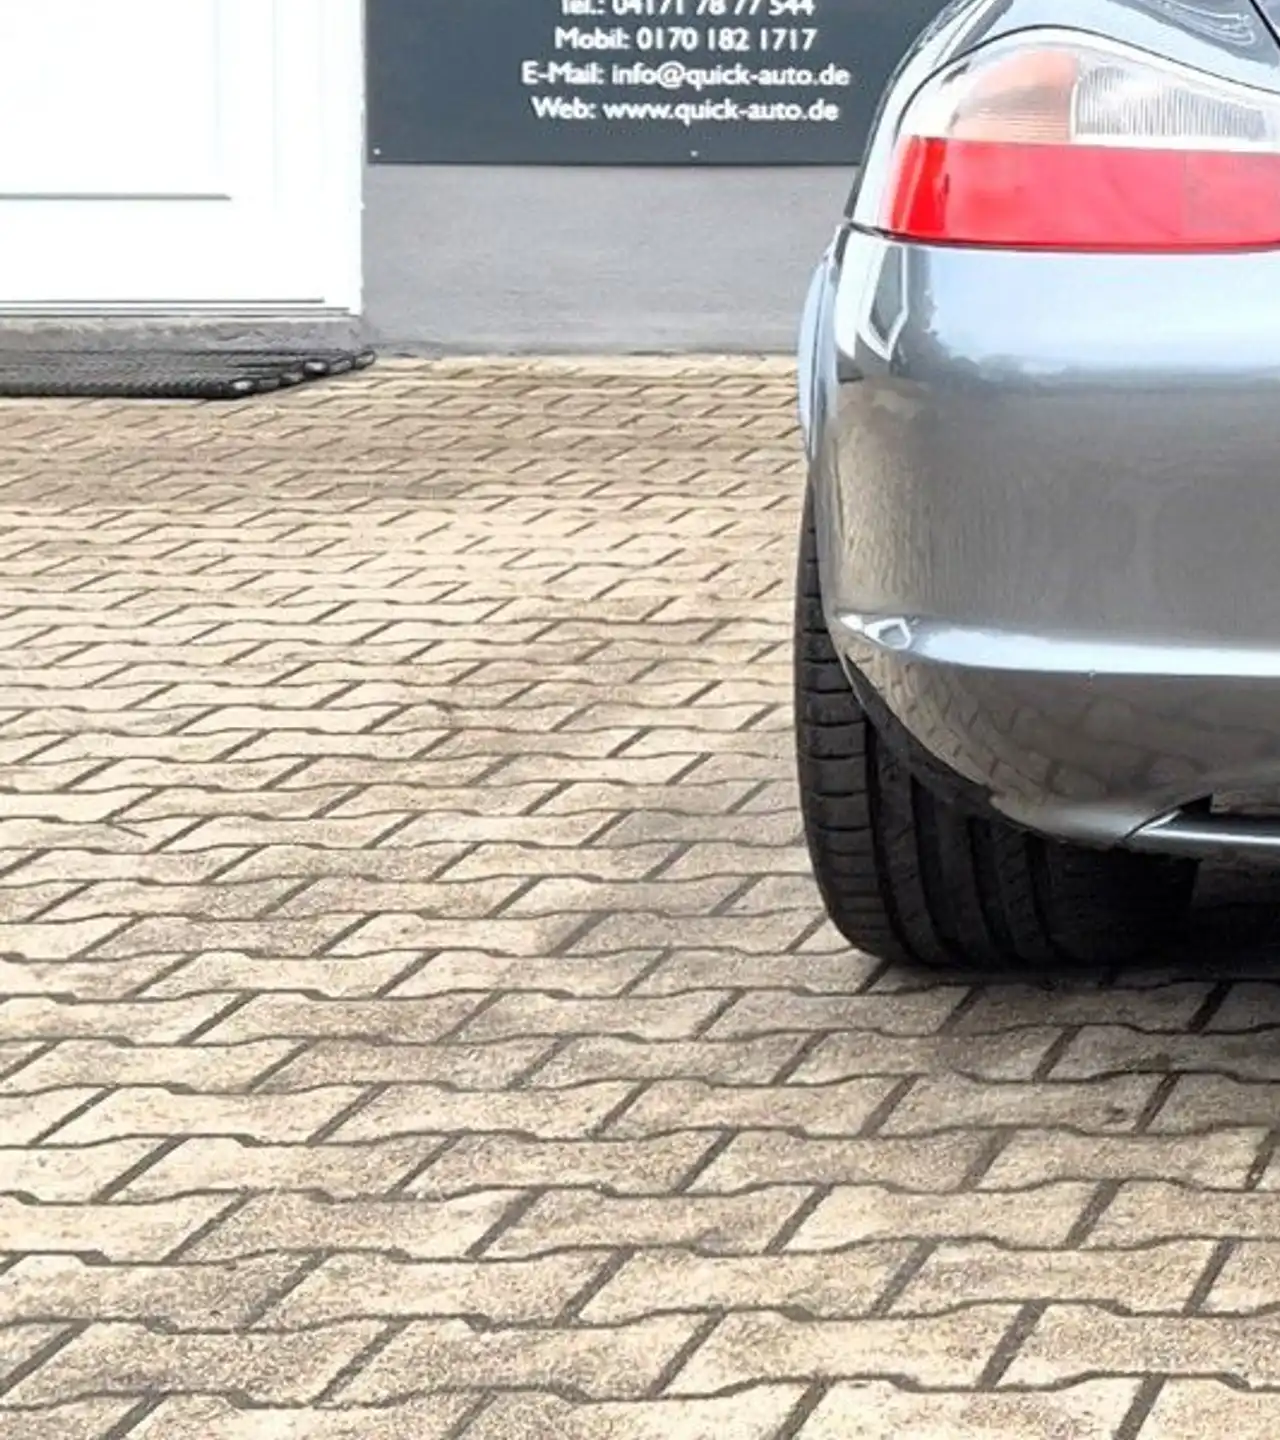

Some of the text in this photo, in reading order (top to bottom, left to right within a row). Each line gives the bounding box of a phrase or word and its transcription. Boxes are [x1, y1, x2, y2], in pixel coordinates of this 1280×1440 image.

[555, 26, 818, 51] Mobil: 0170 182 1717
[522, 61, 851, 91] E-Mail: info@quick-auto.de
[531, 96, 840, 127] Web: www.quick-auto.de
